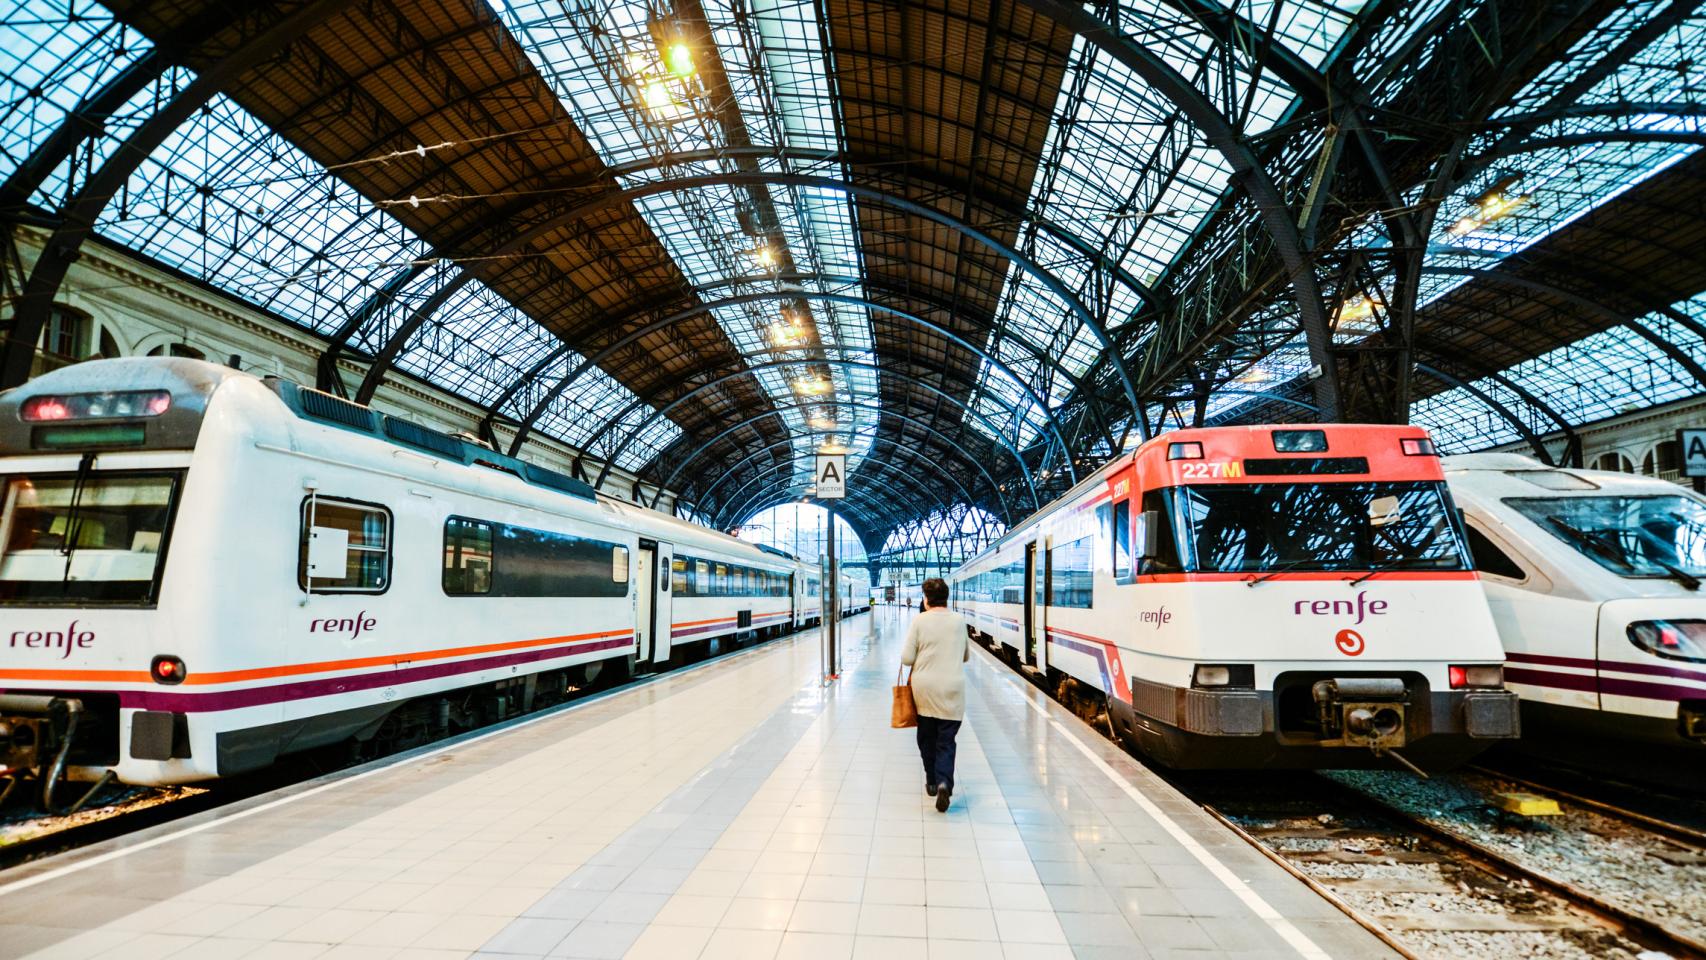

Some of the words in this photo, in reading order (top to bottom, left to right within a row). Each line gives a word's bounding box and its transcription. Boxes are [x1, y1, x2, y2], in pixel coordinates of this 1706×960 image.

[1688, 435, 1706, 460] A
[821, 461, 841, 483] A
[1182, 461, 1241, 478] 227M
[1140, 605, 1172, 629] renfe
[1294, 590, 1388, 624] renfe
[310, 610, 377, 640] renfe
[10, 619, 95, 659] renfe
